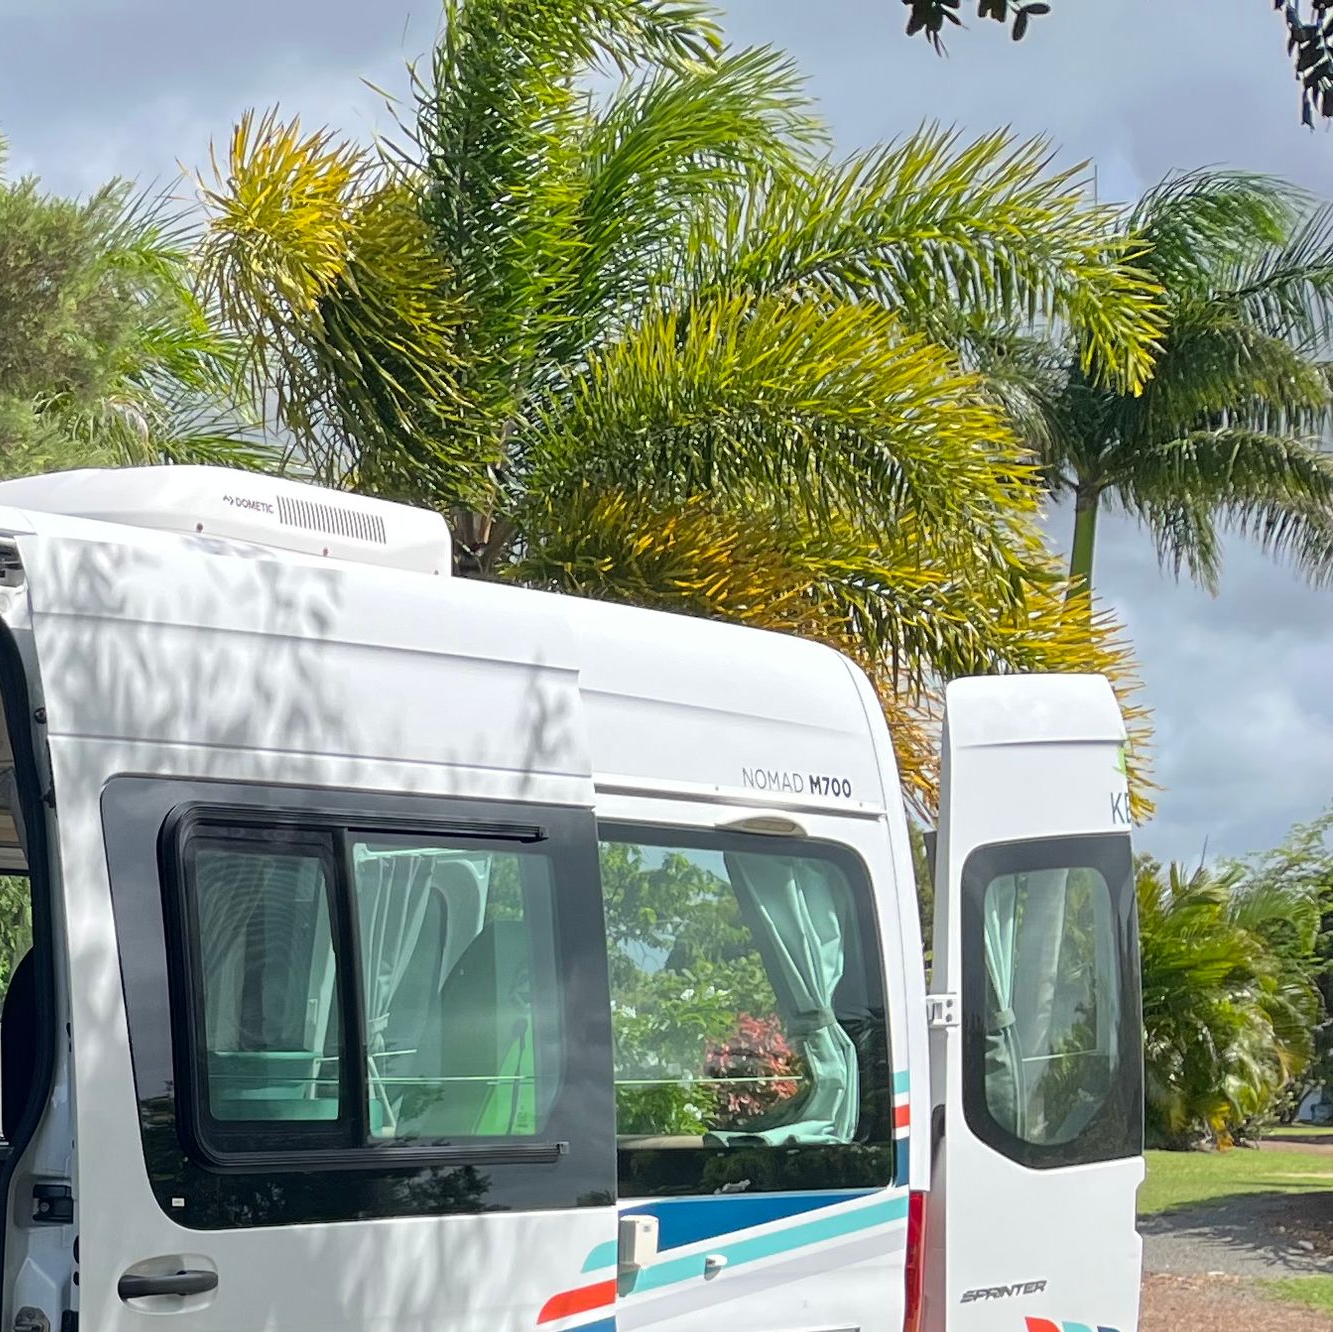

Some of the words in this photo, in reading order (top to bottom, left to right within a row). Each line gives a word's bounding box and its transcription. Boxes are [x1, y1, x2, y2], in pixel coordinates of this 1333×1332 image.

[235, 497, 274, 514] DOMETIC
[742, 767, 804, 793] NOMAD
[809, 774, 852, 798] M700
[960, 1280, 1047, 1304] SPRINTER
